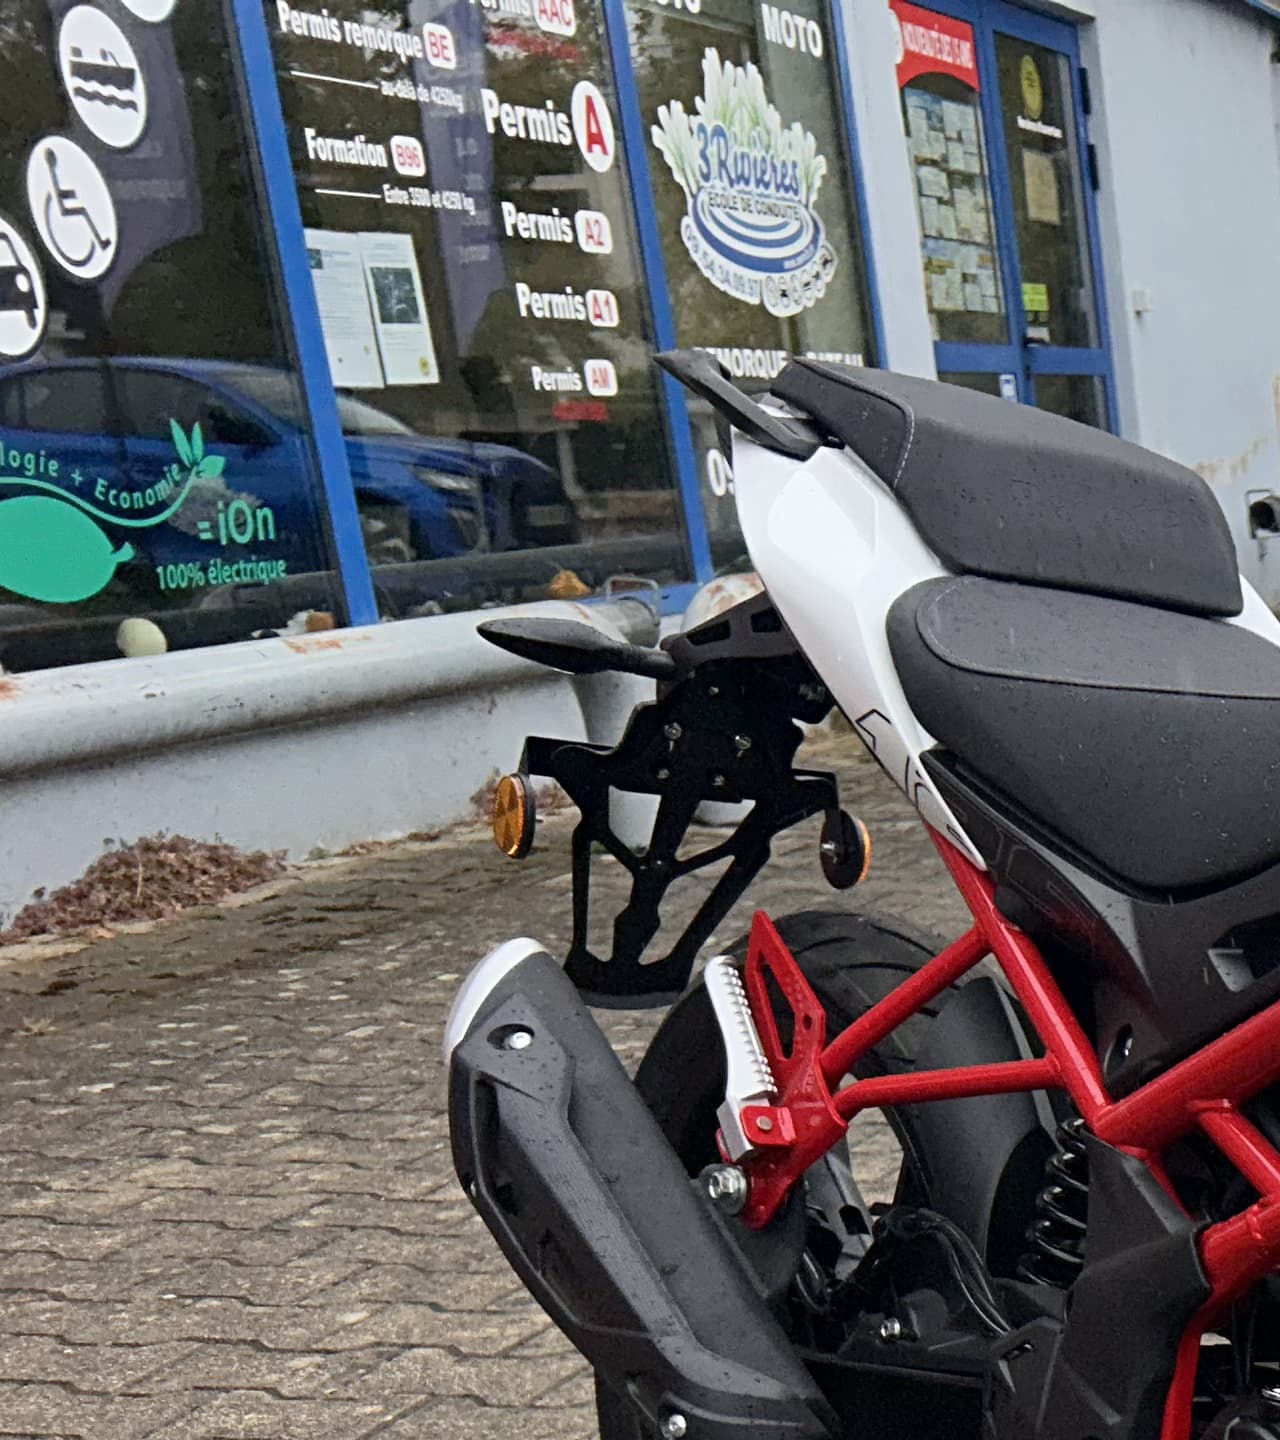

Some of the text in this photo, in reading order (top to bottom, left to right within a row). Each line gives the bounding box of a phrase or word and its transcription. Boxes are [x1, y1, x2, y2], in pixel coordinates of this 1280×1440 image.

[277, 0, 342, 42] Permis
[344, 20, 423, 64] remorque
[428, 31, 452, 62] BE
[761, 3, 823, 58] MOTO
[480, 88, 609, 156] Permis A
[304, 127, 422, 169] Formation B96
[697, 122, 712, 183] 3
[501, 201, 605, 247] Permis A2
[708, 190, 739, 212] ECOLE
[740, 196, 754, 215] DE
[515, 282, 614, 323] Permis A1
[531, 366, 584, 391] Permis
[95, 463, 182, 509] Economie
[156, 556, 287, 590] 100% électrique
